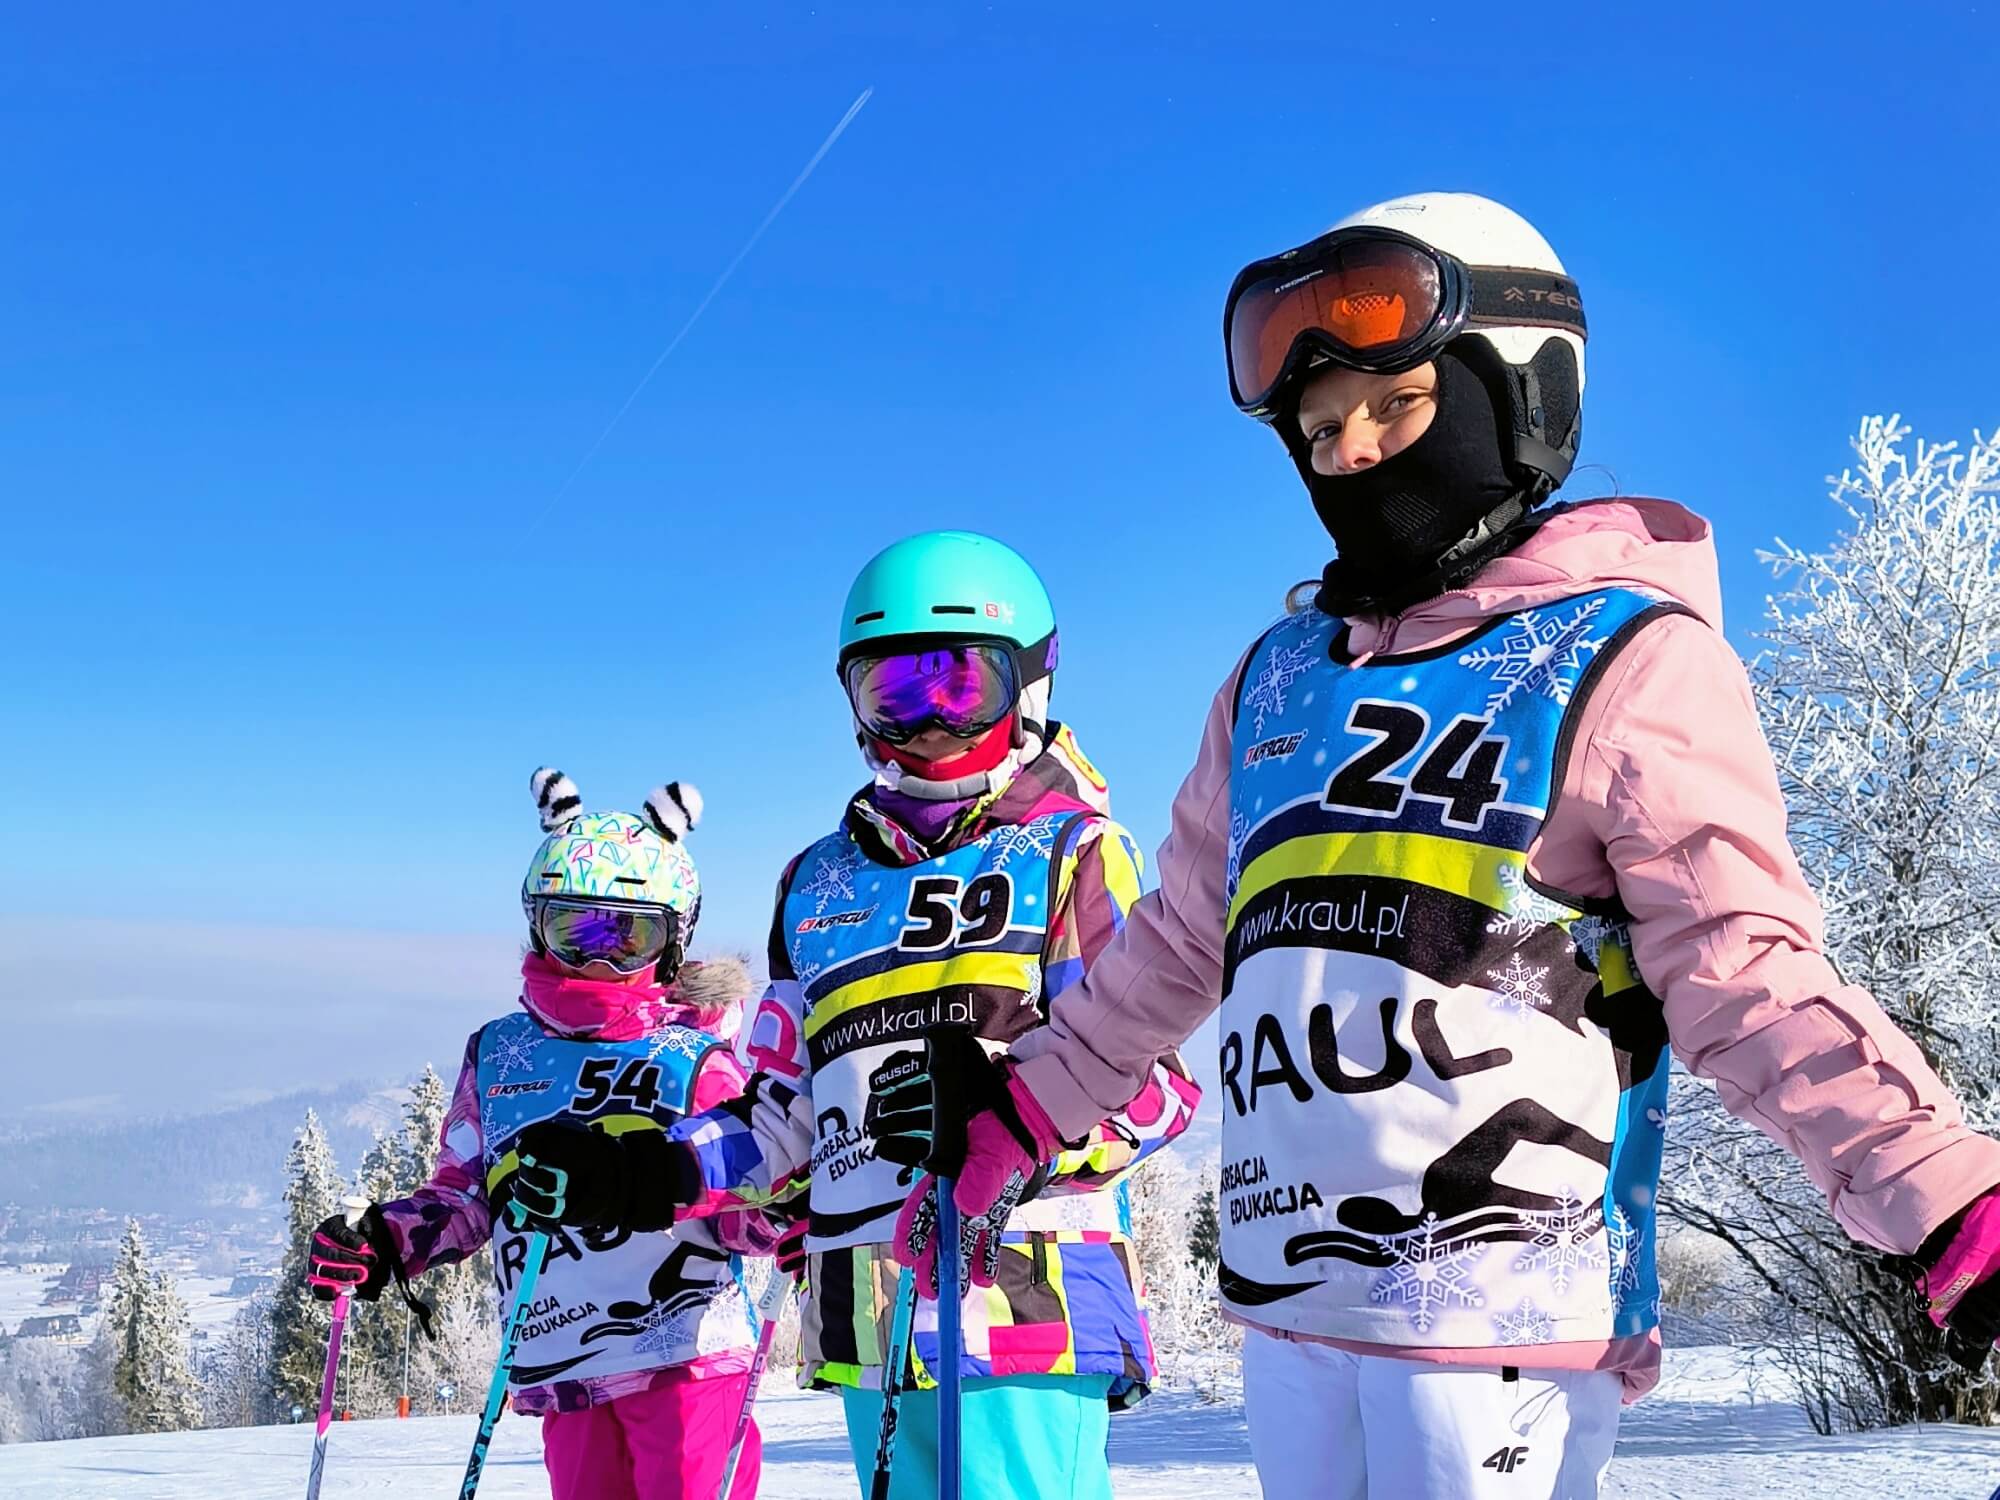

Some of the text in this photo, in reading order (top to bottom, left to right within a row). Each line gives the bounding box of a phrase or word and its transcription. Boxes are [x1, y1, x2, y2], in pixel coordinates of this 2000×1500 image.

[1321, 699, 1509, 830] 24
[898, 872, 1013, 950] 59
[1238, 890, 1409, 953] www.kraul.pl
[822, 992, 977, 1055] www.kraul.pl
[569, 1057, 662, 1114] 54
[874, 1059, 919, 1086] reusch
[1220, 998, 1513, 1126] RAUL
[1230, 1182, 1324, 1226] EDUKACJA
[521, 1301, 600, 1342] EDUKACJA
[1482, 1446, 1529, 1473] 4F
